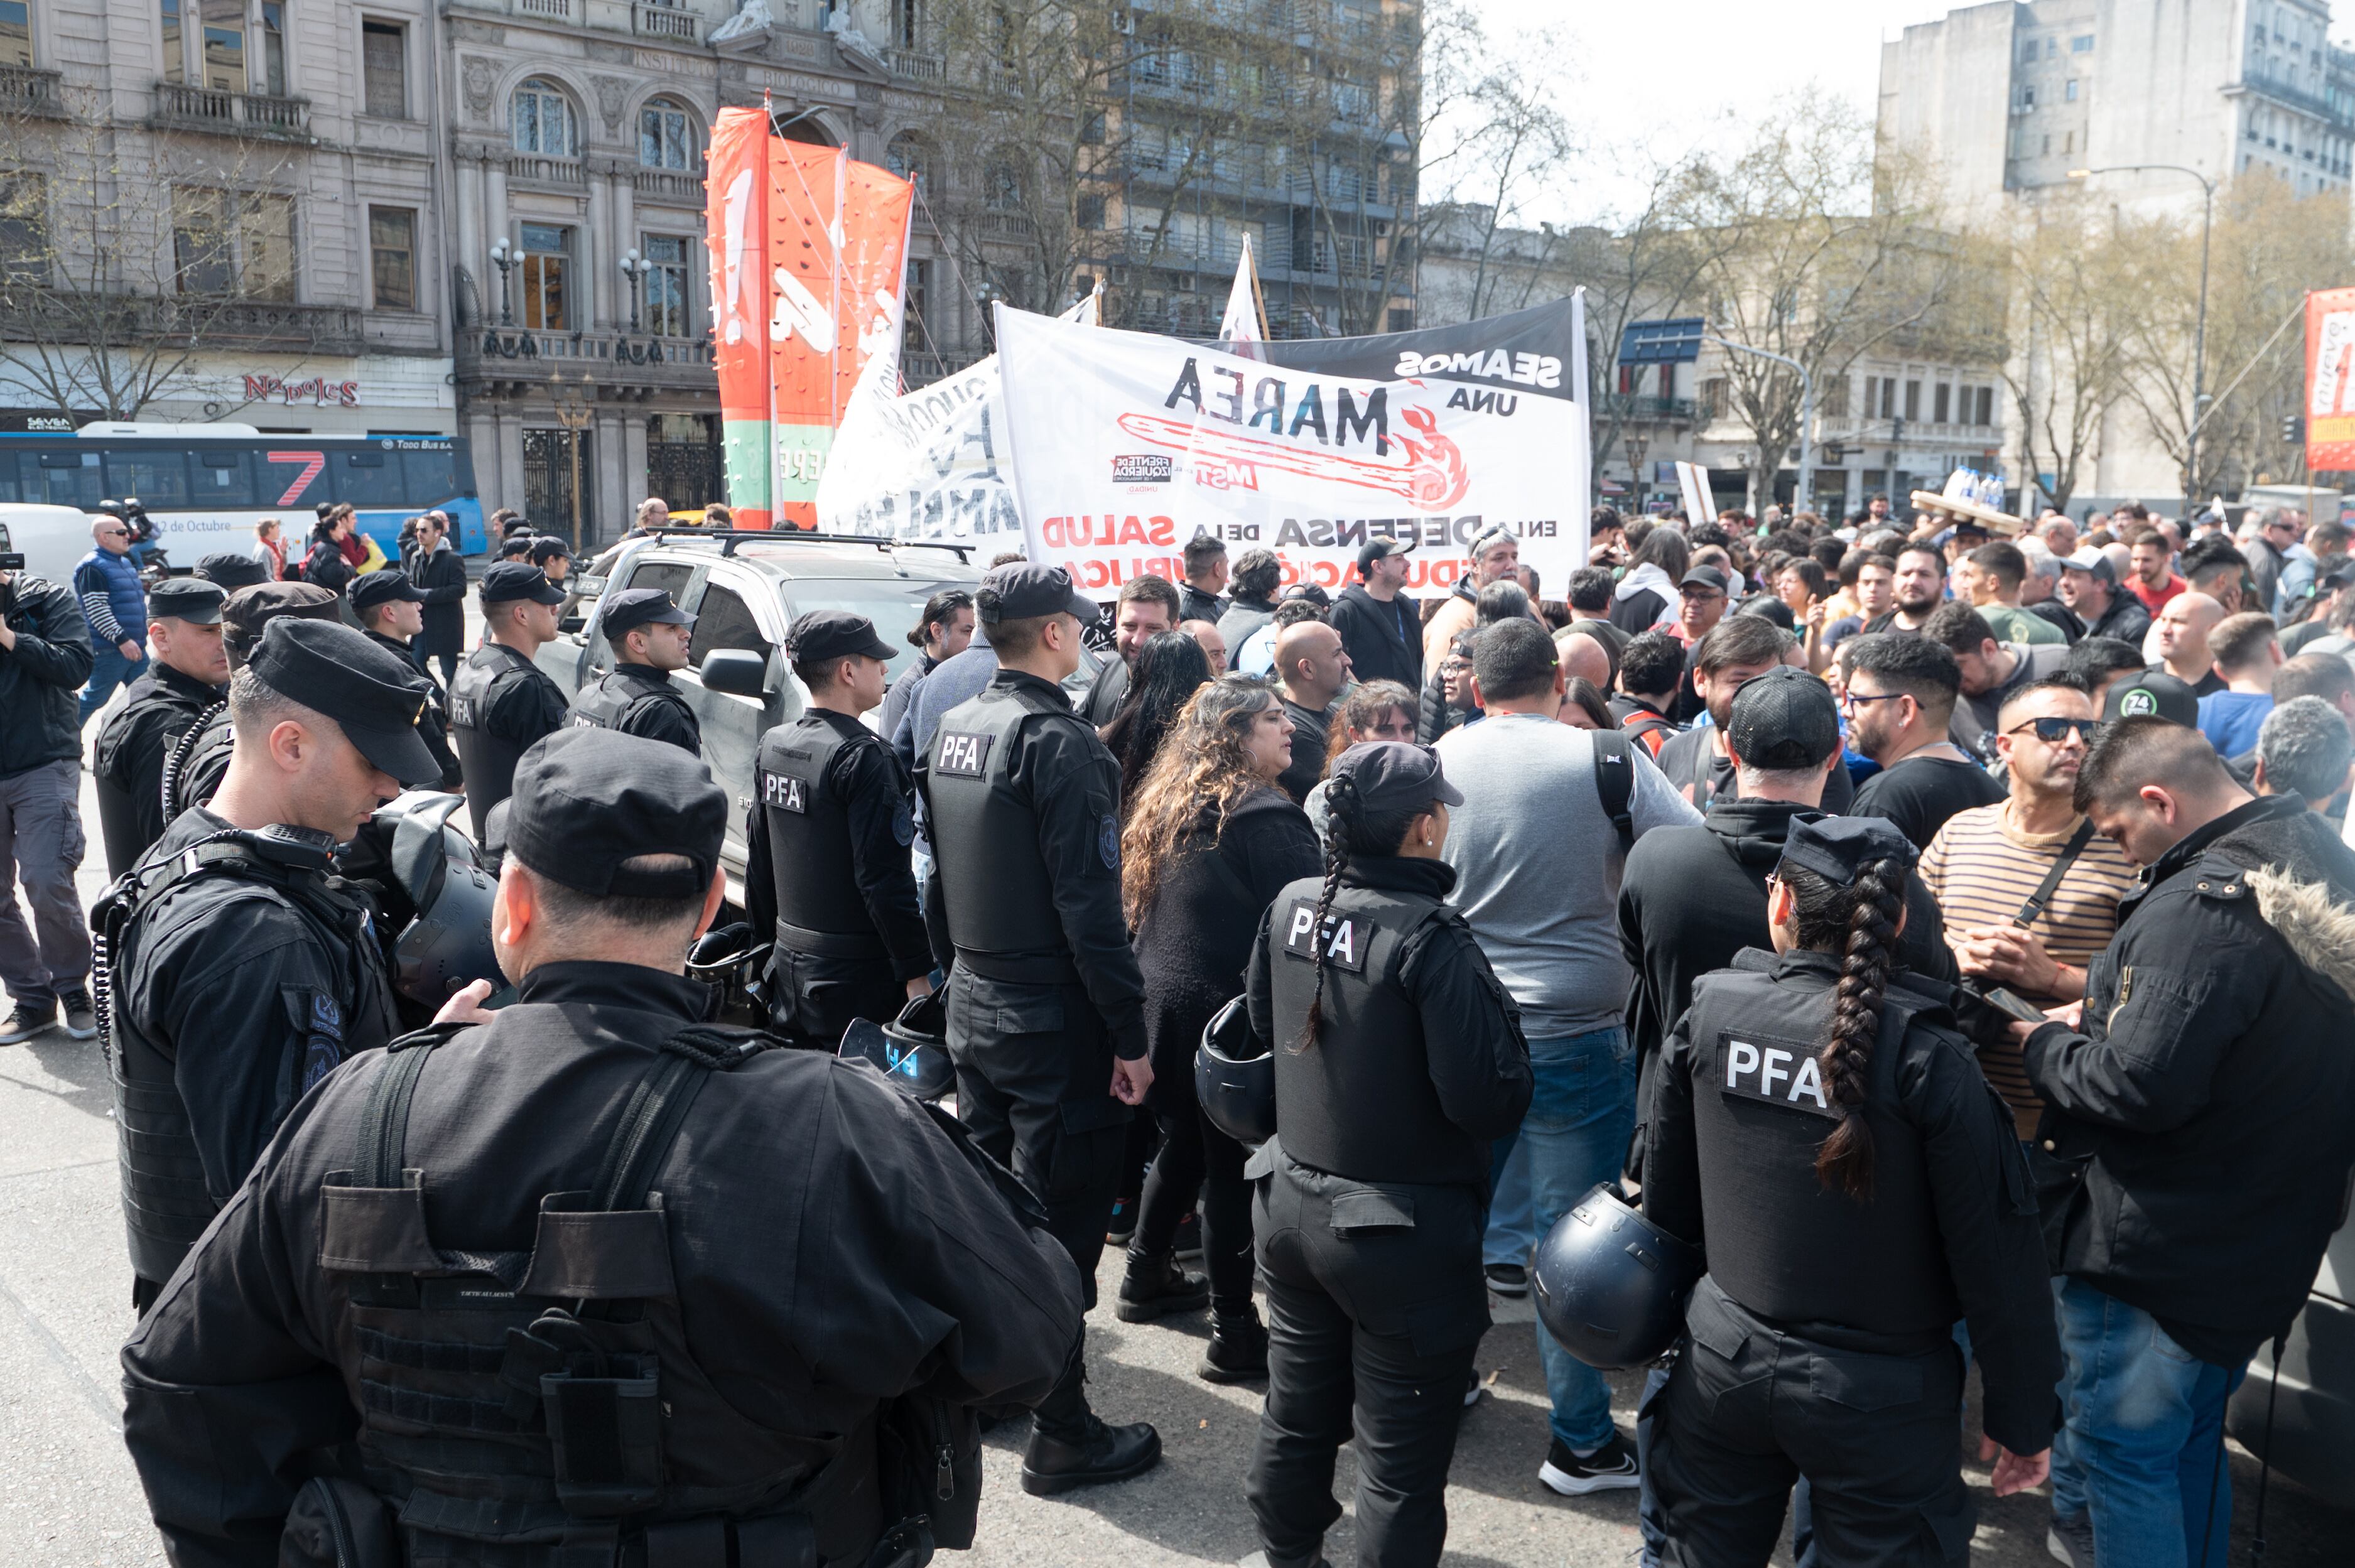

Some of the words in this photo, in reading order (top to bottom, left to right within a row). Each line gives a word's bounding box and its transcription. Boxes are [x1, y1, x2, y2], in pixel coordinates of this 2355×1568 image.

[635, 51, 715, 77] INSTITUTO
[764, 70, 840, 95] BIOLOGICO
[267, 451, 325, 506] 7
[170, 520, 185, 533] de
[187, 520, 231, 533] Octubre
[452, 698, 471, 723] PFA
[939, 735, 977, 770] PFA
[766, 773, 800, 809] PFA
[1288, 906, 1353, 963] PFA
[1727, 1040, 1827, 1109] PFA
